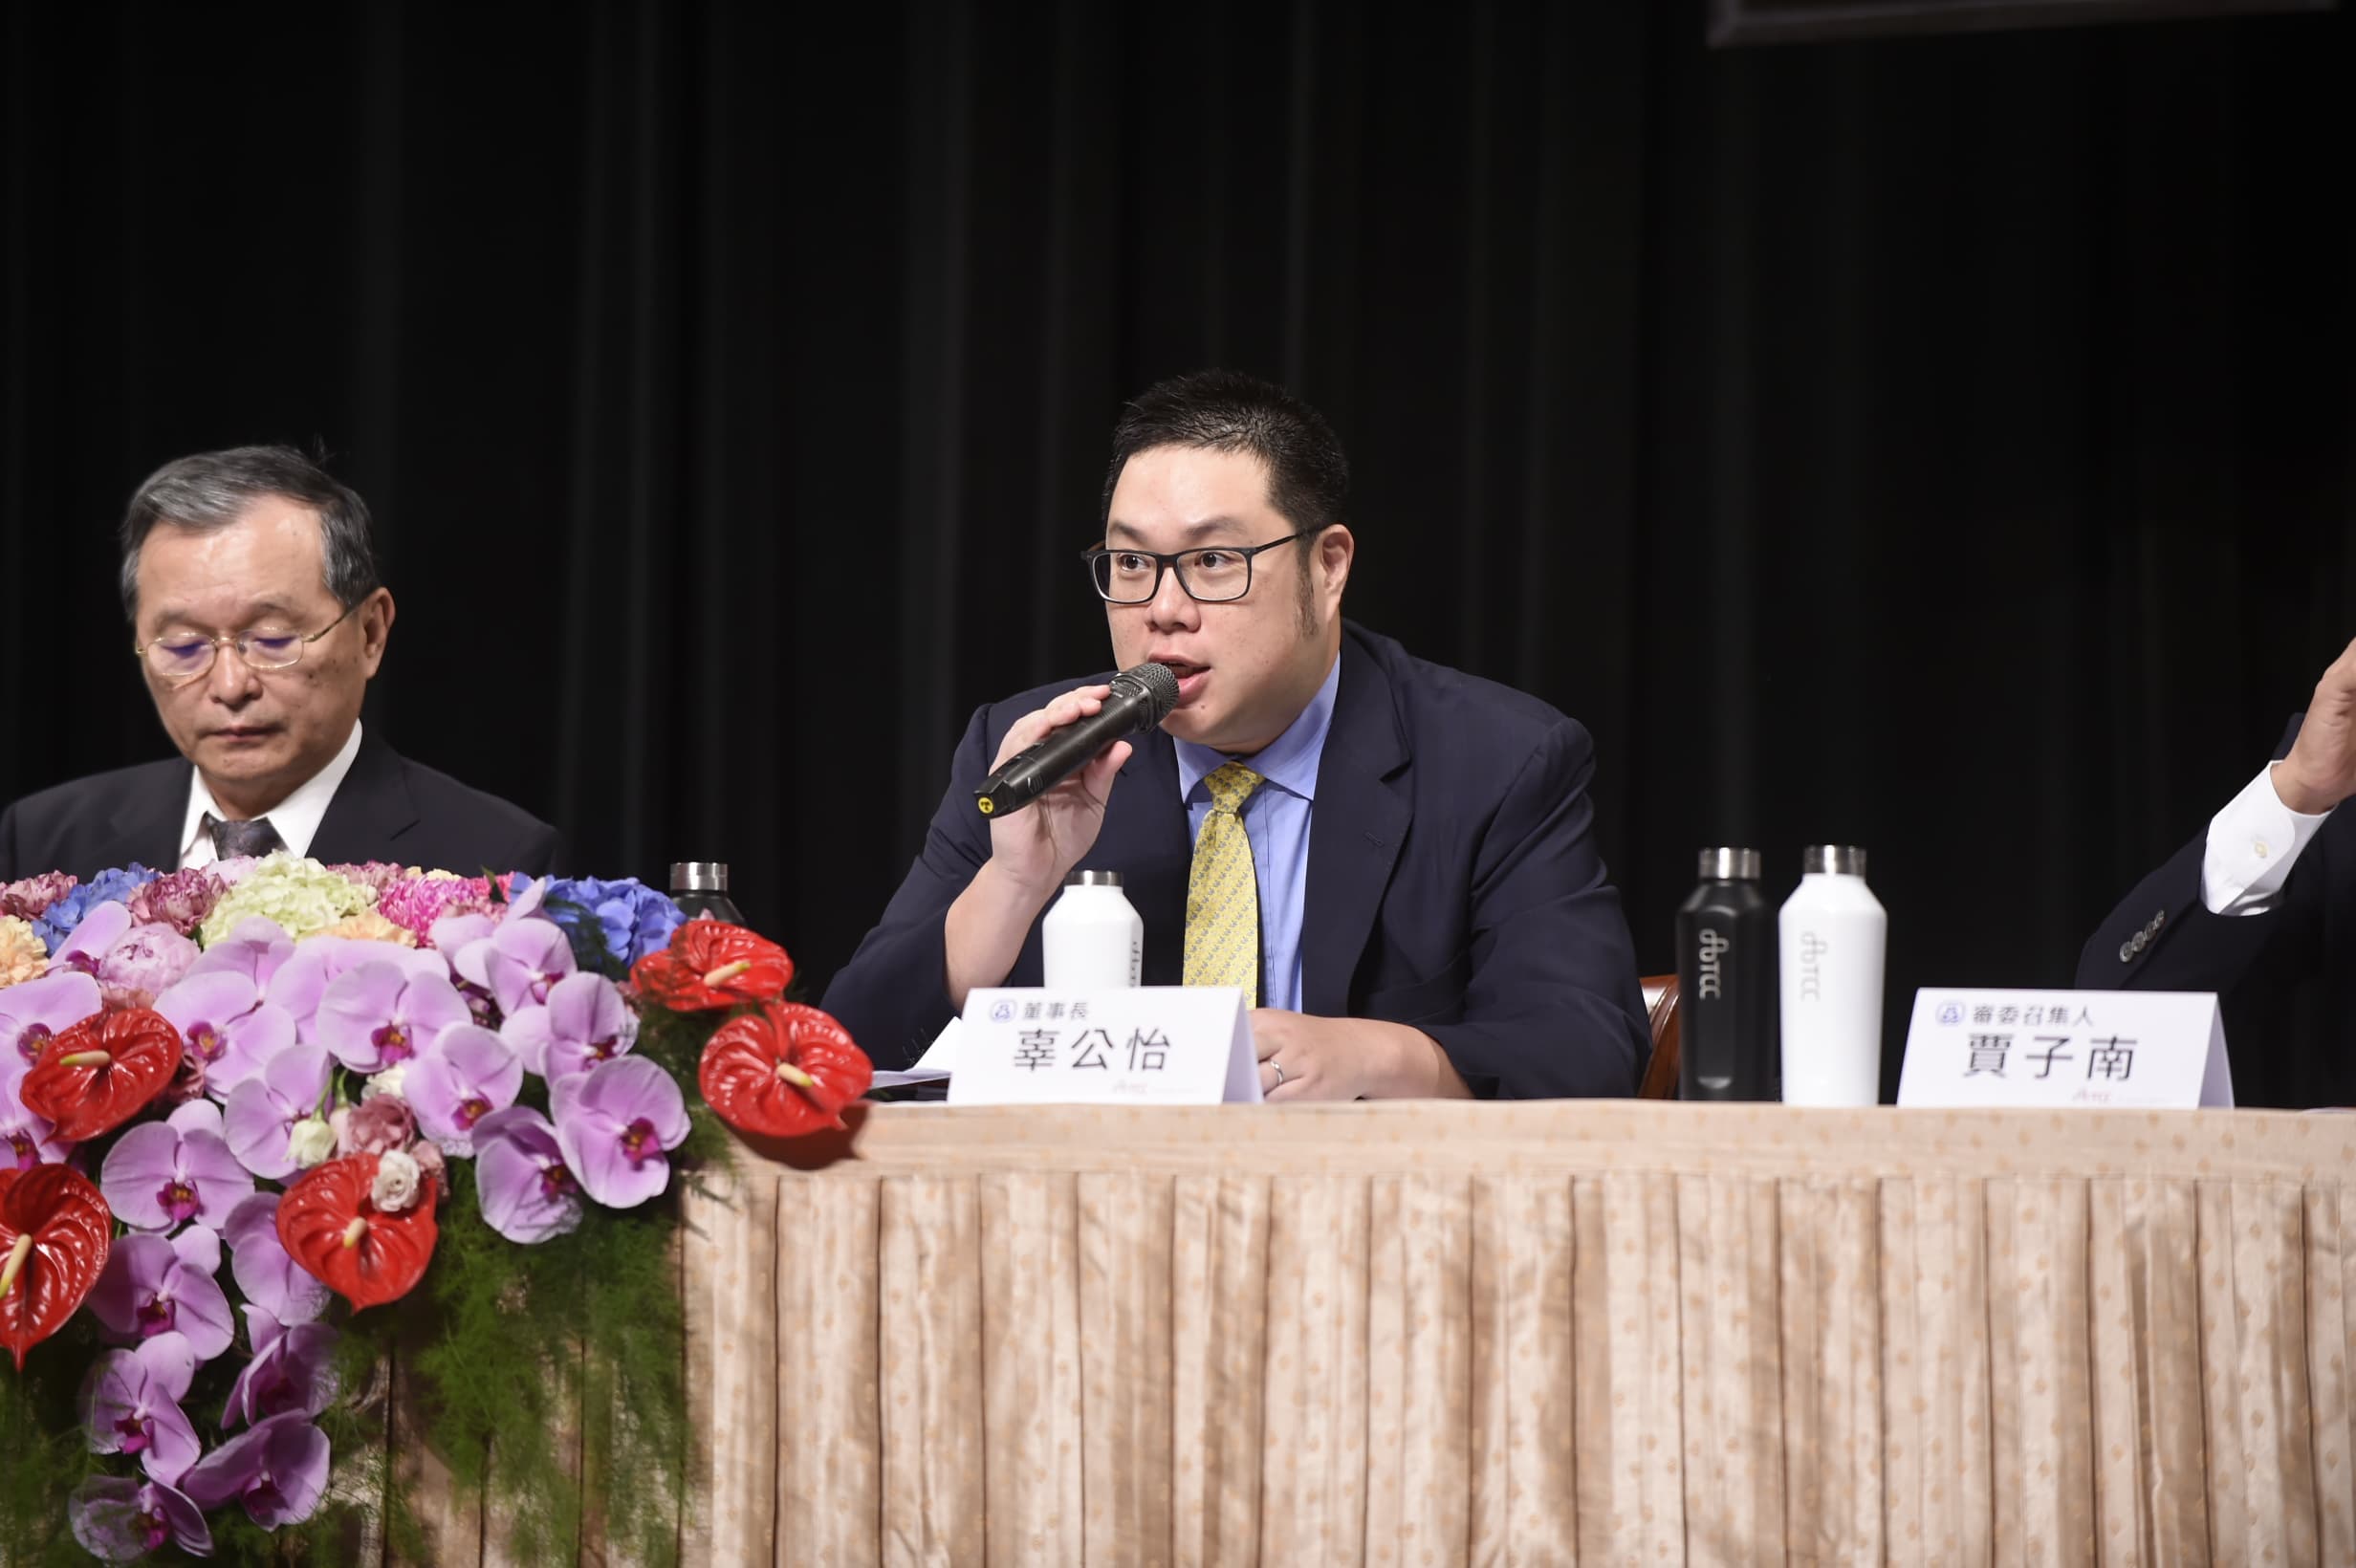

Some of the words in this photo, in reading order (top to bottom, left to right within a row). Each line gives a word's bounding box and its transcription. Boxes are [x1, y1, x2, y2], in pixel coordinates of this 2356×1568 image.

[1023, 1001, 1089, 1020] 董事長
[1014, 1028, 1171, 1072] 辜公怡
[1962, 1033, 2138, 1082] 賈子南
